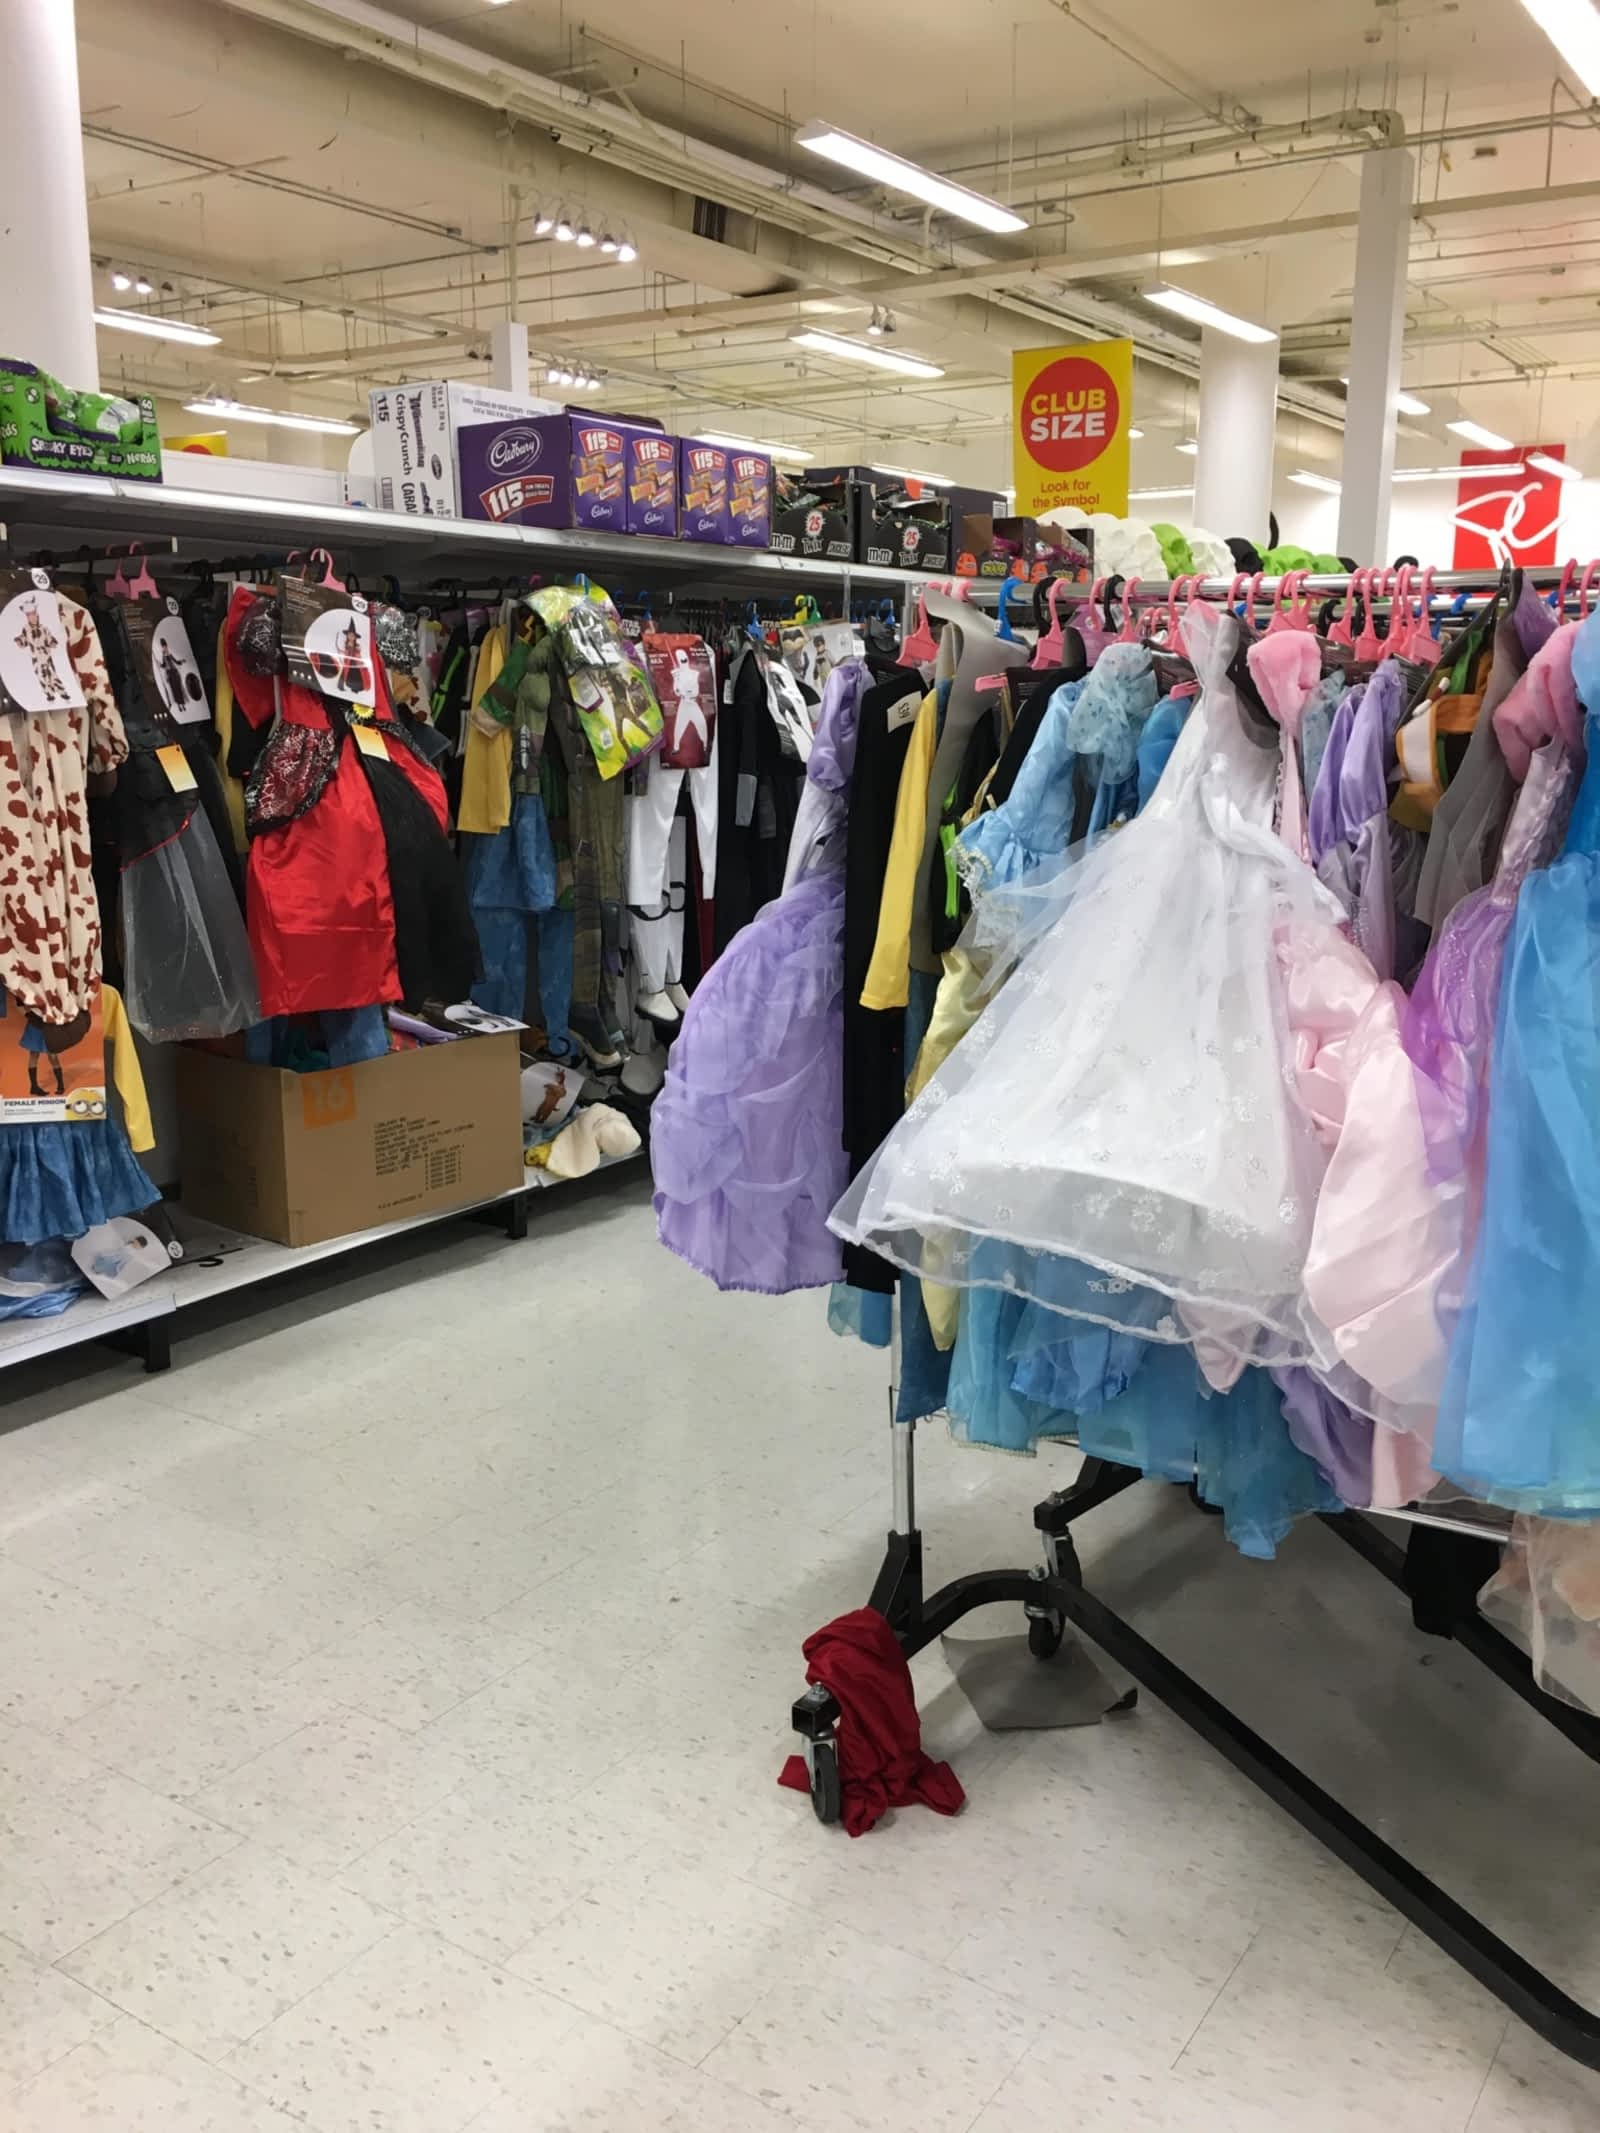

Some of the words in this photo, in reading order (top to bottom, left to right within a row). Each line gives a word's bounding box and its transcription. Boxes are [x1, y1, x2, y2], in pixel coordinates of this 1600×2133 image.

[1031, 388, 1106, 415] CLUB
[1029, 411, 1106, 442] SIZE
[69, 441, 94, 457] EYES
[586, 432, 609, 452] 115
[639, 441, 660, 461] 115
[490, 440, 535, 468] Cadbury
[694, 451, 713, 471] 115
[738, 459, 755, 478] 115
[1040, 481, 1070, 493] Look
[1073, 479, 1091, 490] for
[400, 482, 418, 513] CARA
[488, 481, 525, 518] 115
[1033, 497, 1050, 508] the
[1053, 493, 1100, 507] Symbol
